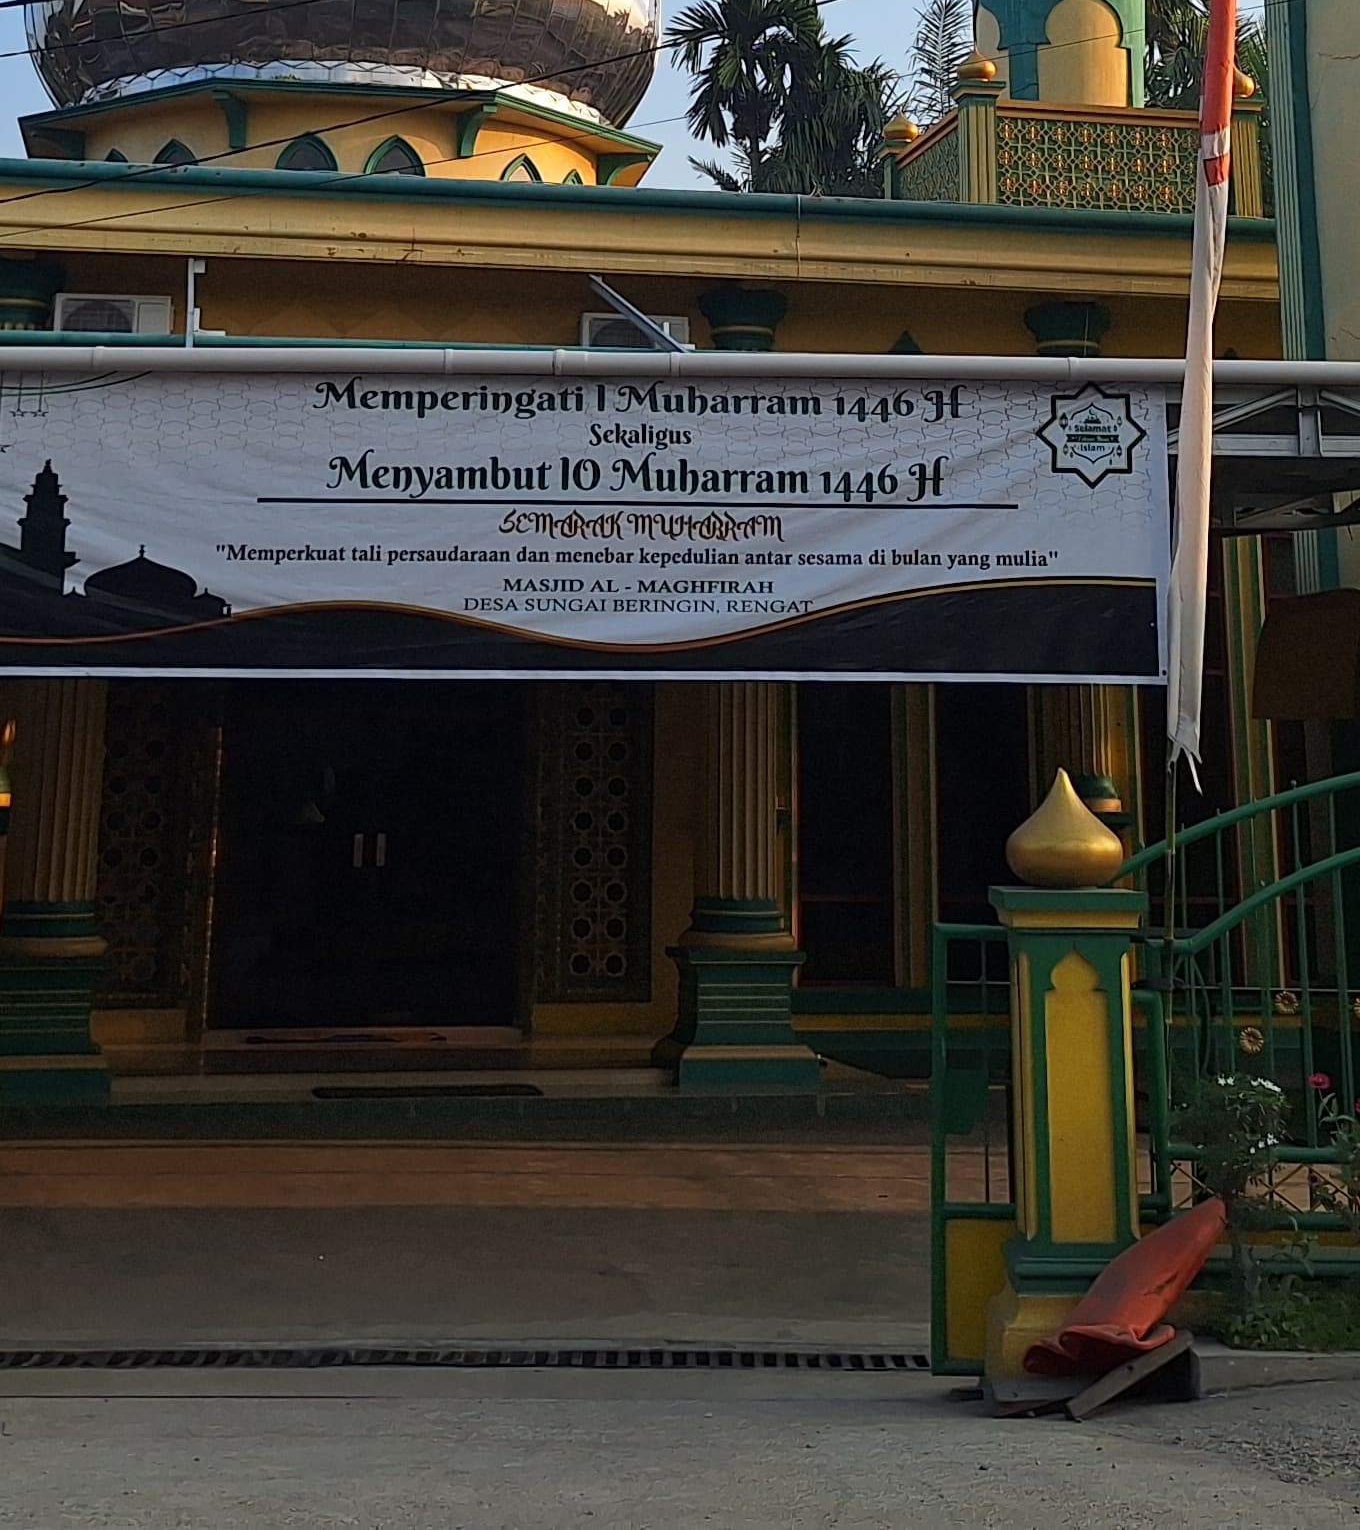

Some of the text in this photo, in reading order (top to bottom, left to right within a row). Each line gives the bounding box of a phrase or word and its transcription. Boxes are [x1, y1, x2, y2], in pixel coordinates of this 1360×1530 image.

[313, 375, 584, 420] Memperingati
[615, 380, 823, 417] Muharram
[833, 388, 915, 424] 1446
[923, 384, 968, 424] H
[589, 423, 692, 450] Sekaligus
[325, 448, 553, 499] Menyambut
[610, 453, 809, 496] Muharram
[819, 462, 899, 503] 1446
[906, 455, 950, 503] H
[498, 508, 785, 542] SEMARAK MUHARRAM
[351, 544, 382, 562] tali
[386, 545, 511, 566] persaudaraan
[516, 545, 550, 563] dan
[555, 546, 635, 564] menebar
[638, 547, 740, 569] kepedulian
[744, 550, 793, 566] antar
[797, 553, 863, 566] sesama
[868, 548, 886, 566] di
[891, 548, 942, 566] bulan
[946, 554, 991, 571] yang
[503, 578, 585, 593] MASJID
[589, 579, 620, 593] AL
[637, 579, 773, 594] MAGHFIRAH
[463, 597, 814, 614] DESA SUNGAI BERINGIN, RENGAT
